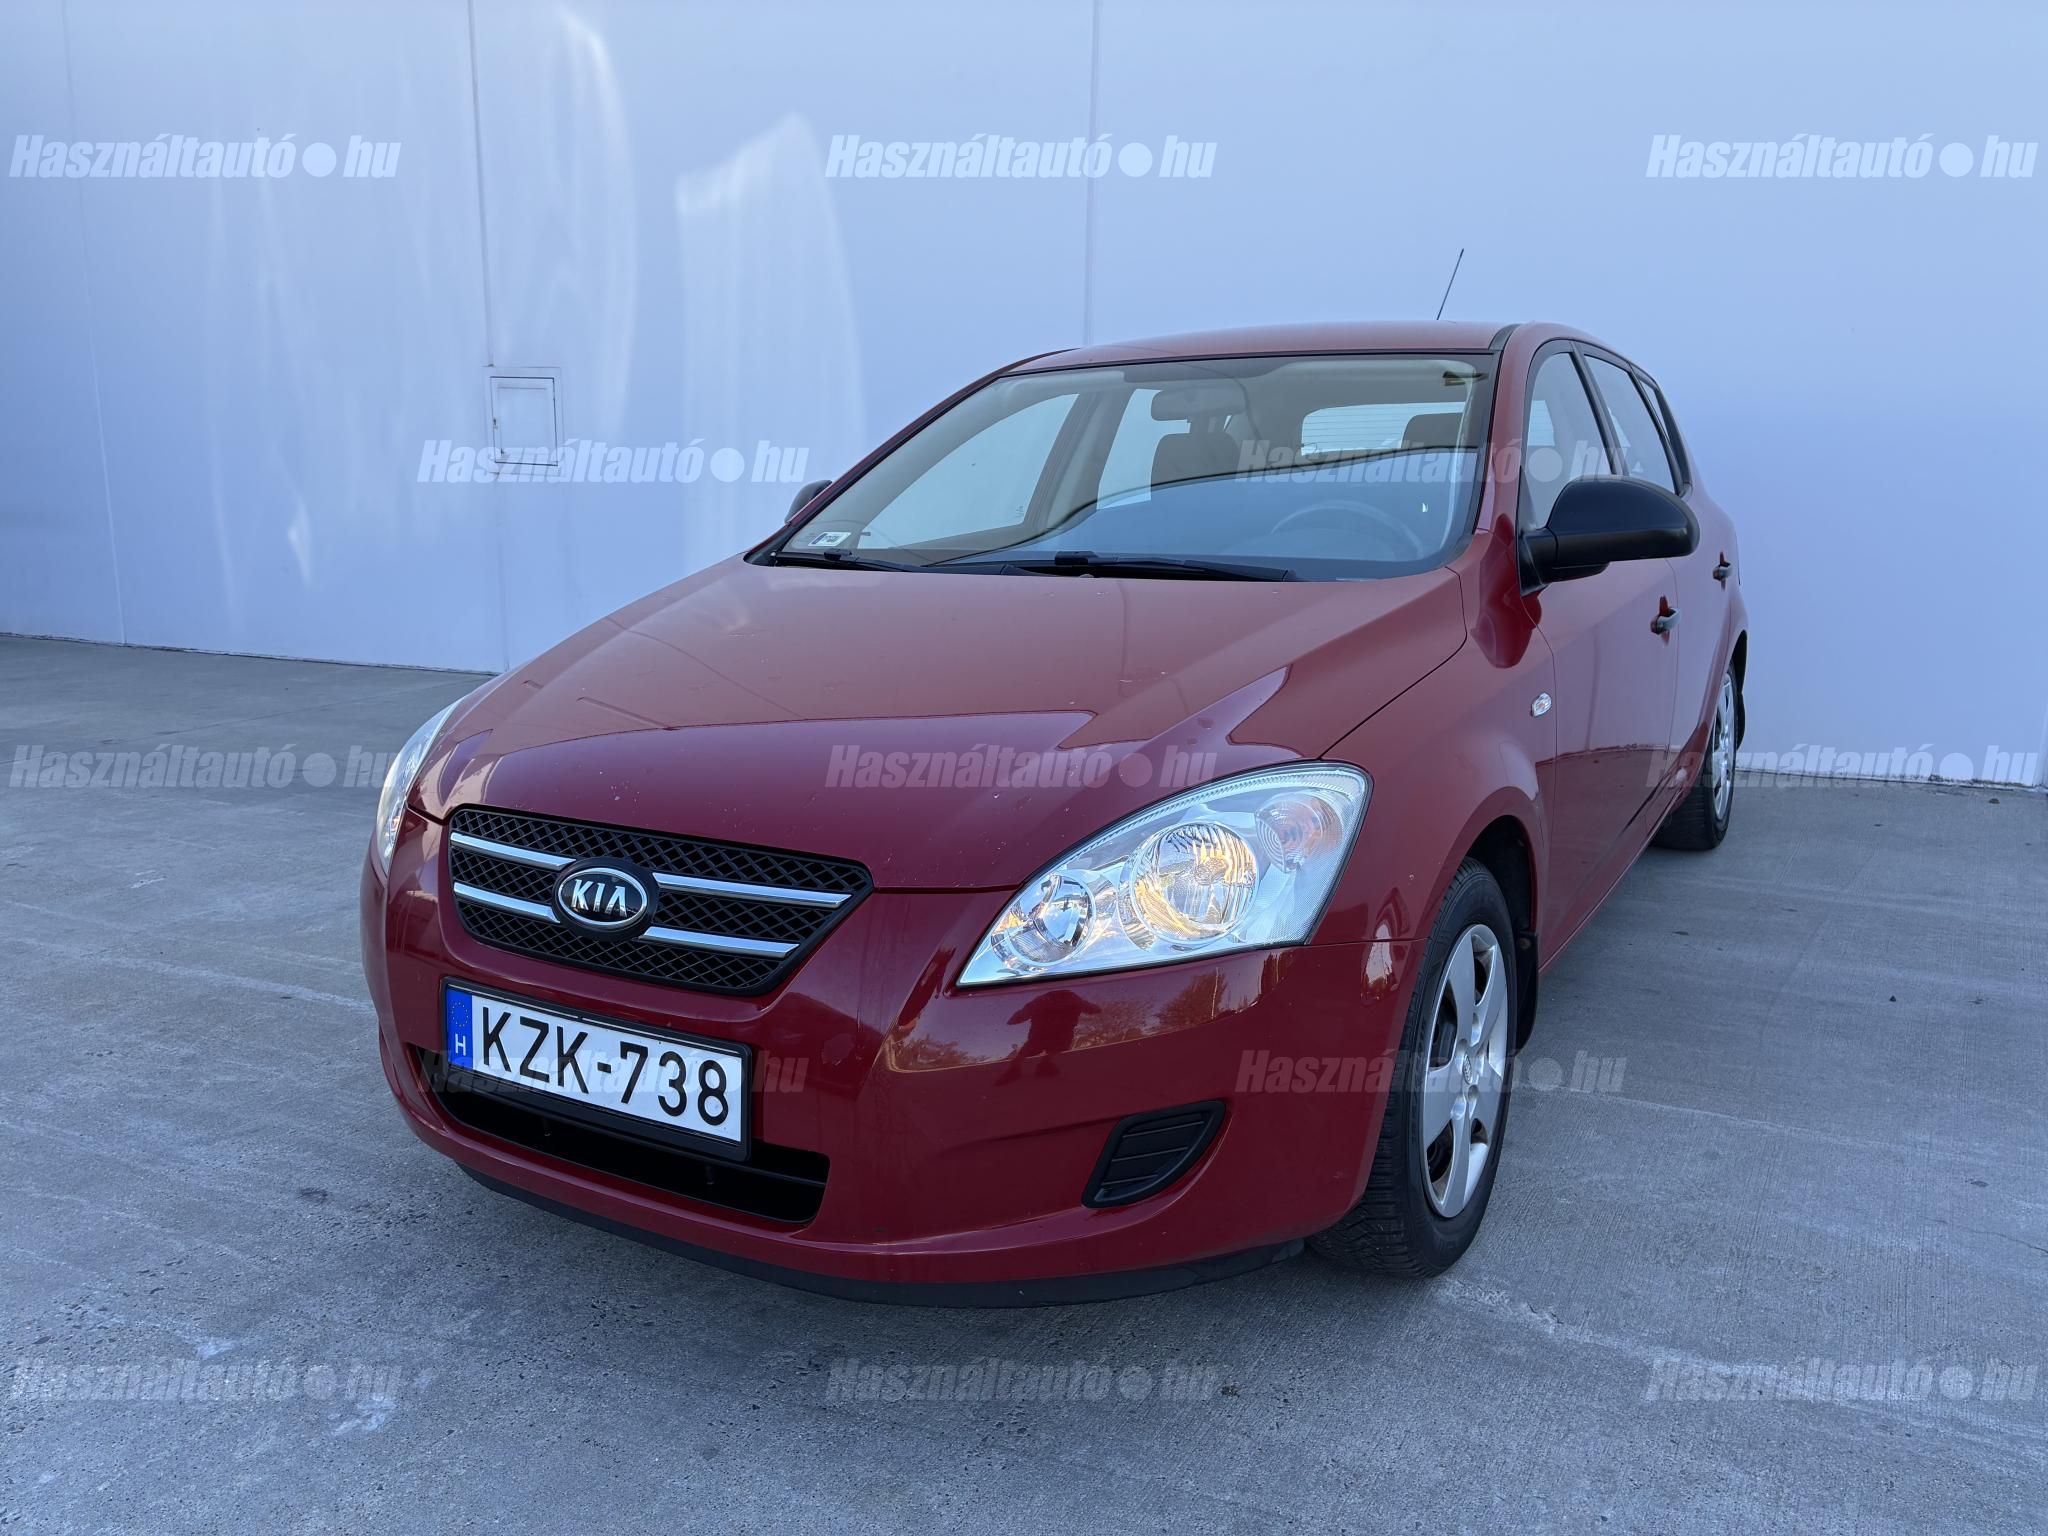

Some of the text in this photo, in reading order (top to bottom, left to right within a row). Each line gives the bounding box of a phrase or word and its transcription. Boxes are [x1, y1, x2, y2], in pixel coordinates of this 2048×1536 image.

[571, 879, 628, 917] KIA
[455, 1006, 729, 1126] H KZK-738
